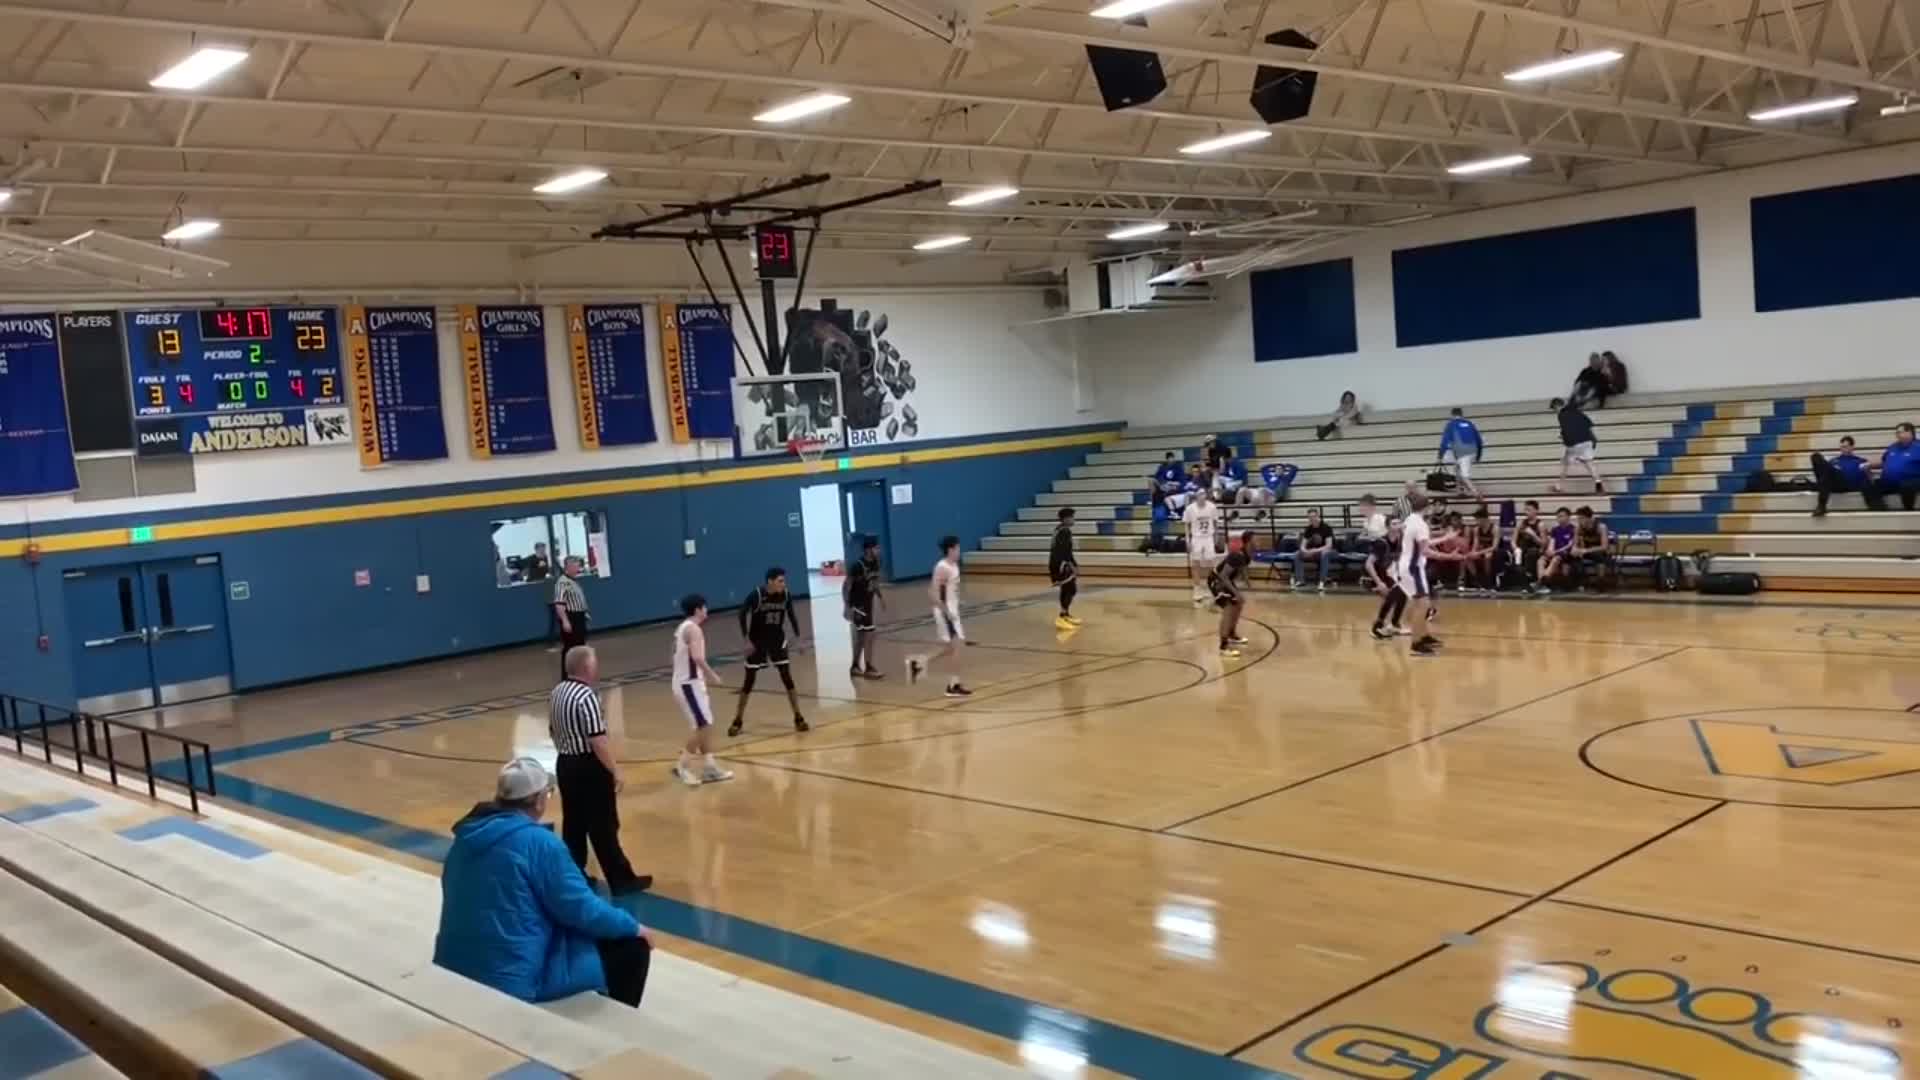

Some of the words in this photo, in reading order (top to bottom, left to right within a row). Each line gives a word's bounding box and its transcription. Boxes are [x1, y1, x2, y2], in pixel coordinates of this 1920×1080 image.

[762, 233, 789, 260] 23
[63, 316, 113, 331] PLAYERS
[136, 313, 181, 325] GUEST
[217, 311, 268, 336] 4:17
[288, 311, 325, 321] HOME
[369, 311, 433, 331] CHAMPIONS
[481, 311, 541, 328] CHAMPIONS
[587, 308, 641, 328] CHAMPIONS
[496, 323, 528, 332] GIRLS
[603, 321, 628, 331] BOYS
[158, 330, 181, 354] 13
[296, 326, 325, 350] 23
[204, 350, 242, 360] PERIOD
[250, 345, 261, 363] 2
[180, 384, 193, 403] 4
[230, 382, 242, 400] 0
[255, 381, 267, 399] 0
[291, 379, 304, 397] 4
[322, 378, 334, 396] 2
[575, 343, 596, 443] BASKETBALL
[667, 344, 685, 426] BASEBALL
[150, 385, 164, 405] 3
[354, 348, 375, 453] WRESTLING
[466, 342, 486, 449] BASKETBALL
[208, 415, 268, 428] WELCOME
[270, 413, 284, 425] TO
[189, 425, 306, 453] ANDERSON
[851, 430, 877, 445] BAR
